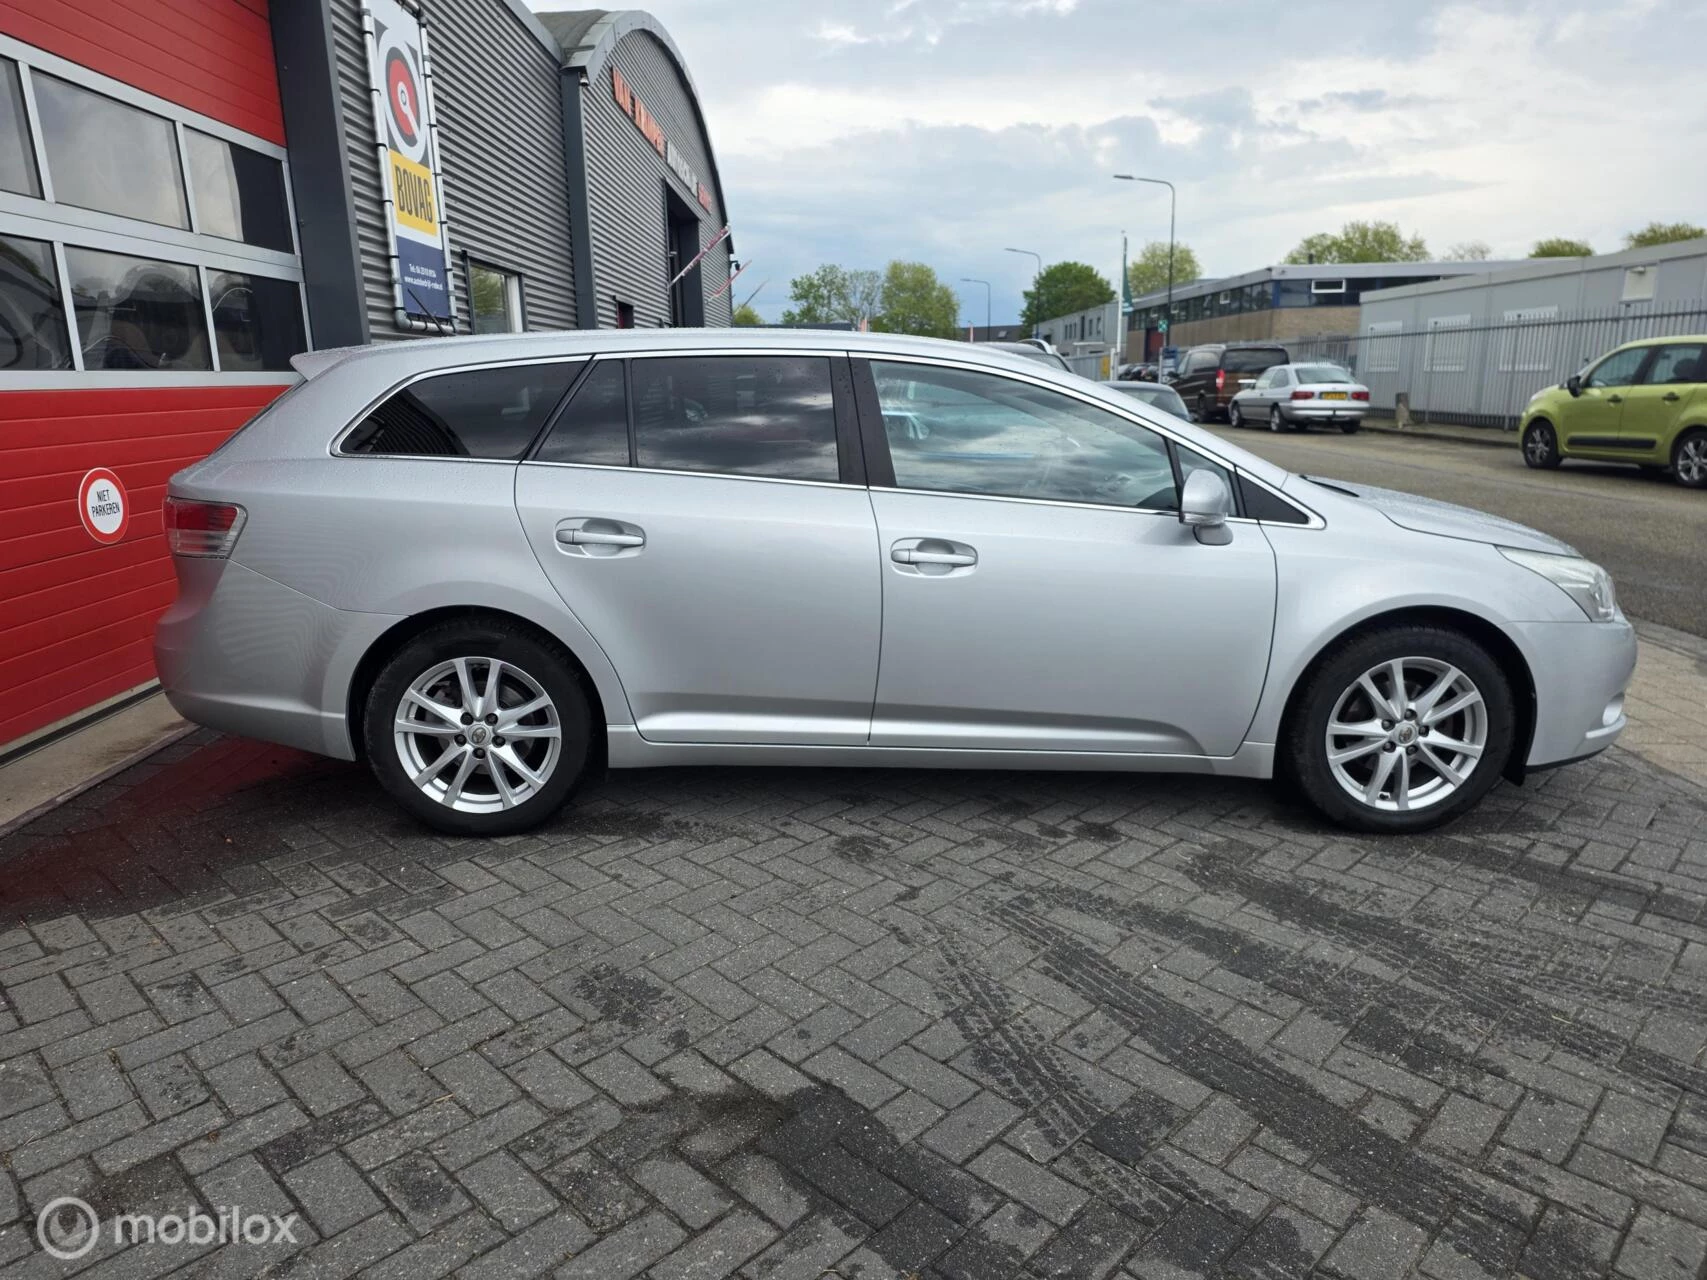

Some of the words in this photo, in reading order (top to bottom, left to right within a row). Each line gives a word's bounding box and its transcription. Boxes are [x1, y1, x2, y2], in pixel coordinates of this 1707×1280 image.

[394, 165, 433, 224] BOVAG
[96, 489, 110, 502] NIET
[91, 502, 120, 517] PARKEREN
